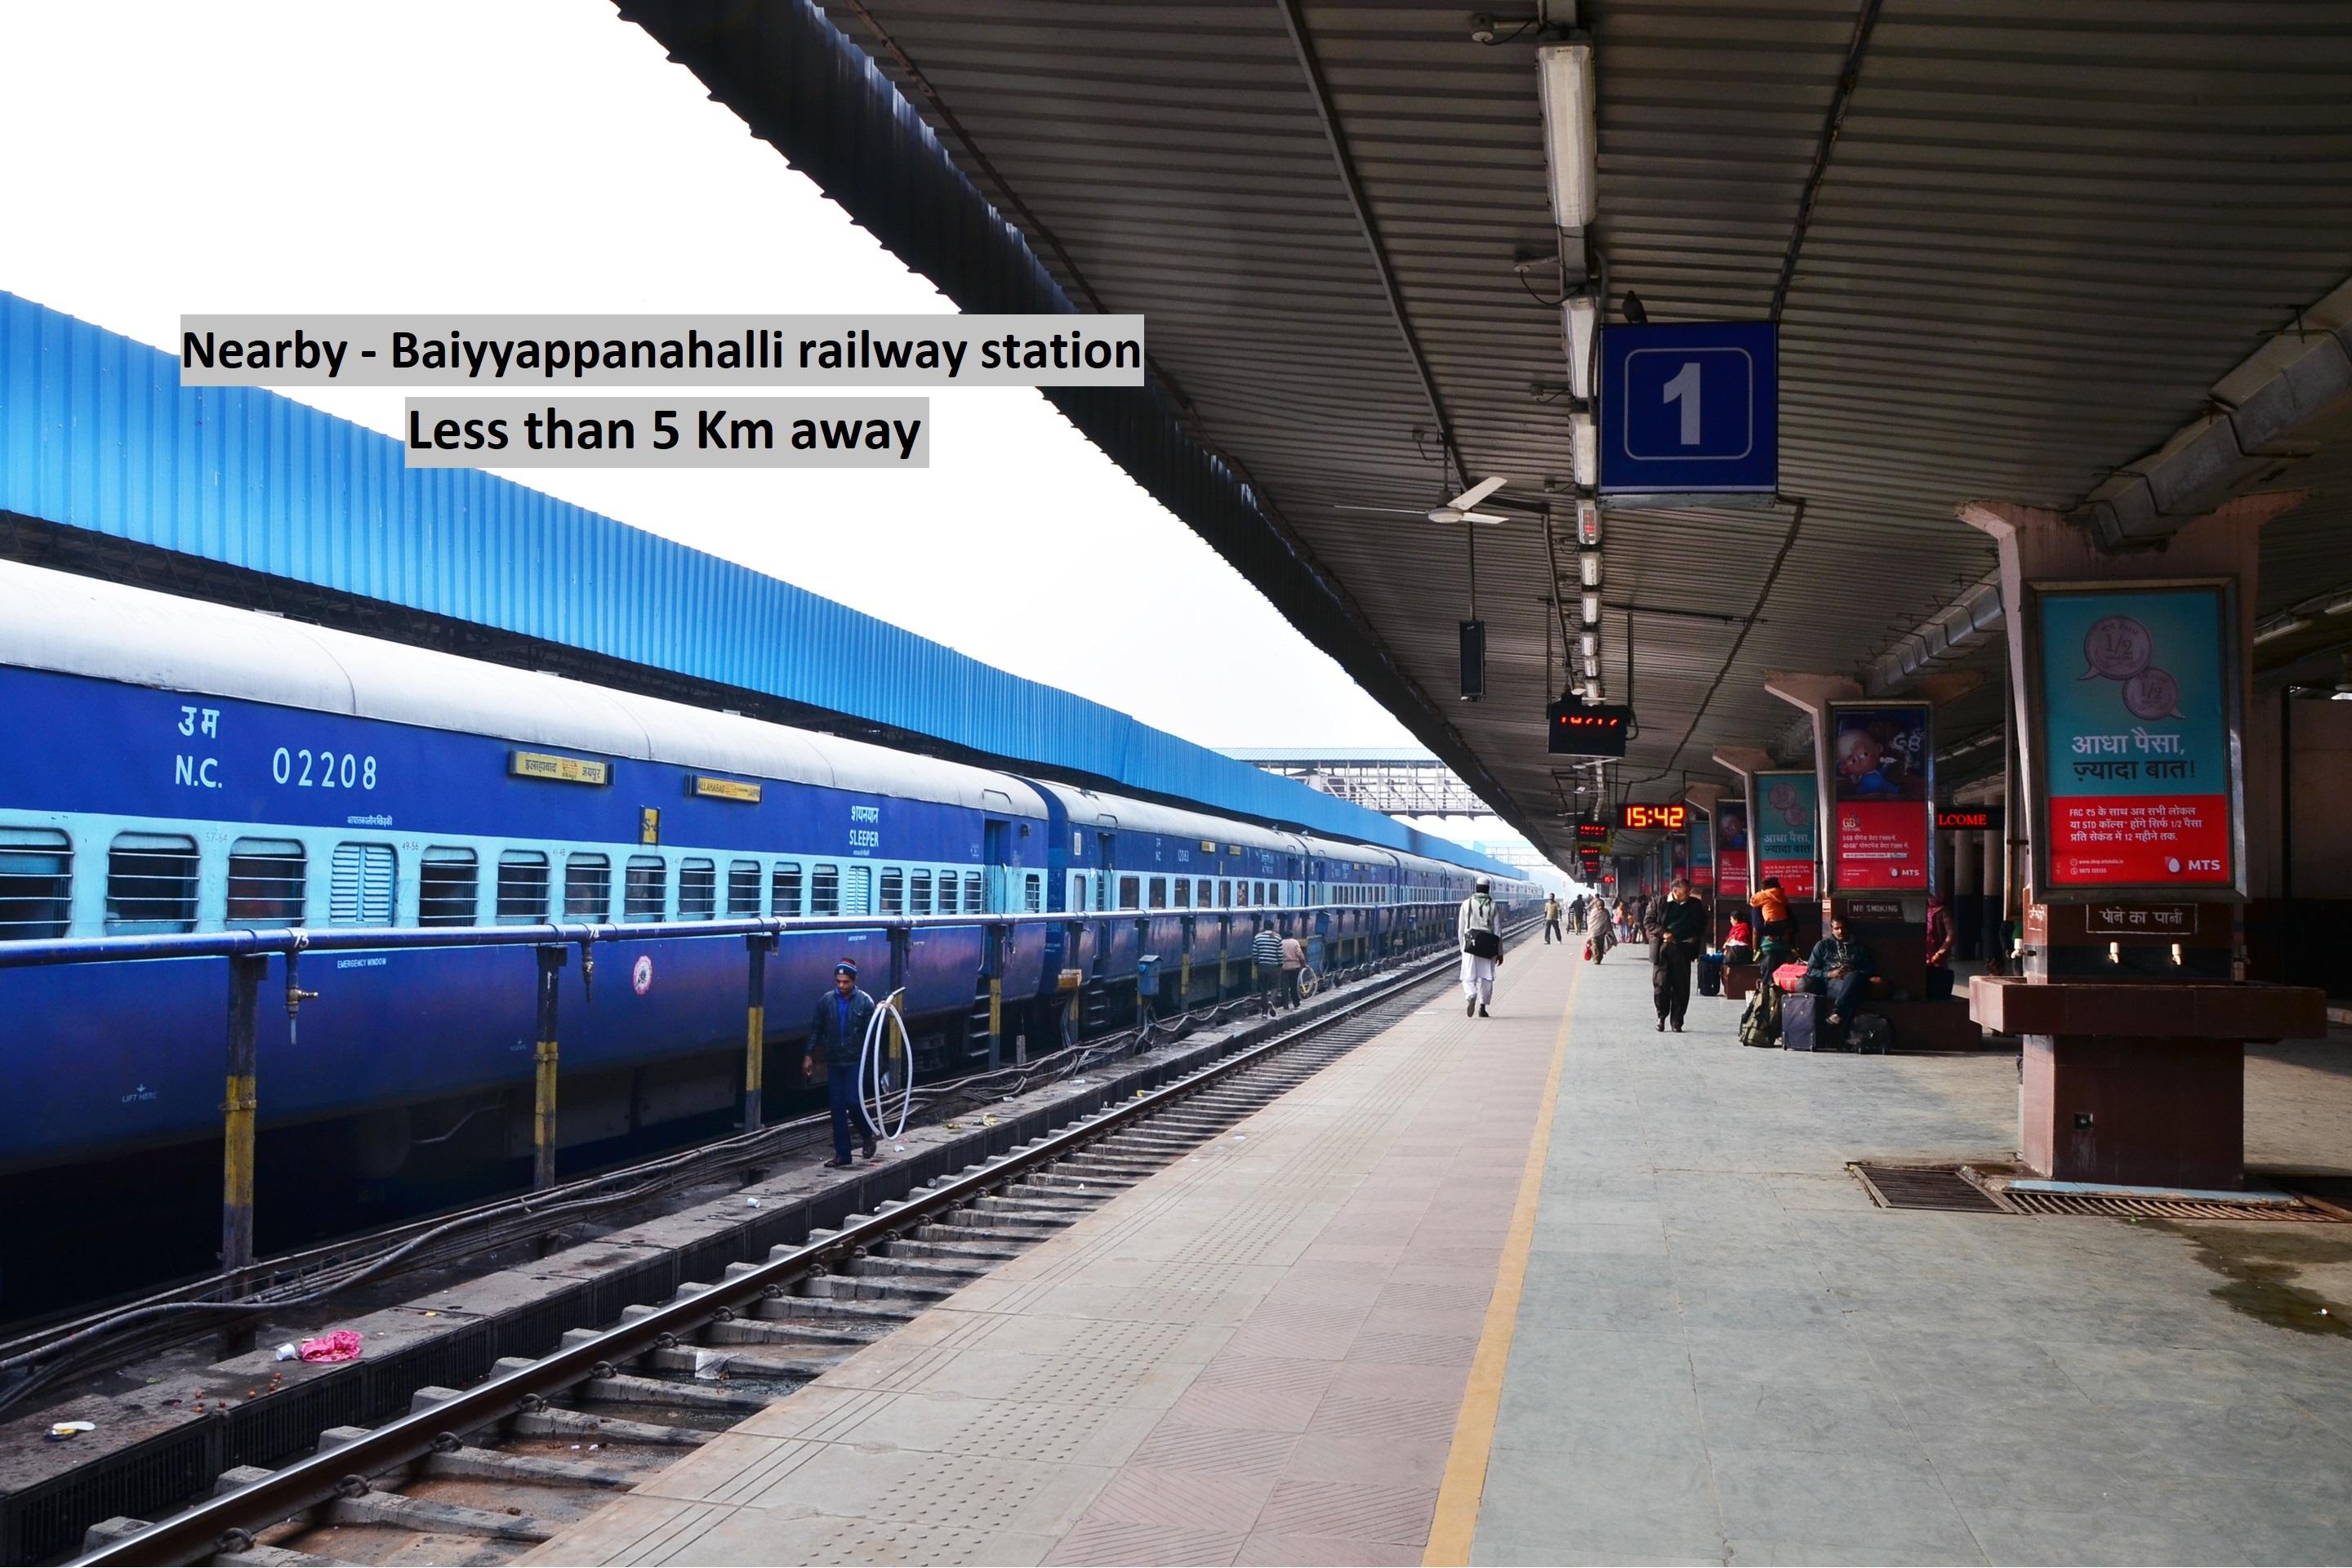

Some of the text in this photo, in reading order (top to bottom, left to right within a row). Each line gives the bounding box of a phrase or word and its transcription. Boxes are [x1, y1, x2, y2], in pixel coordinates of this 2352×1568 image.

[1664, 363, 1700, 444] 1
[177, 706, 220, 739] उम
[2072, 727, 2185, 755] आधा पैसा,
[175, 755, 222, 789] N.C.
[273, 746, 376, 790] 02208
[582, 767, 601, 781] जयपुर
[851, 805, 879, 823] शयनयान
[1627, 807, 1684, 826] 15:42
[2070, 808, 2083, 817] FRC
[2098, 806, 2106, 816] के
[2109, 808, 2127, 816] साथ
[2131, 808, 2145, 816] अब
[2149, 805, 2165, 816] सभी
[2168, 805, 2195, 816] लोकल
[1938, 814, 1987, 826] LCOME
[2070, 821, 2080, 829] या
[2184, 817, 2202, 828] पैसा
[849, 830, 879, 847] SLEEPER
[2071, 831, 2087, 841] प्रति
[2135, 831, 2157, 841] महीने
[2189, 860, 2221, 871] MTS
[2099, 906, 2183, 924] पीने का पानी
[337, 958, 386, 969] EMERGENCY WINDOW
